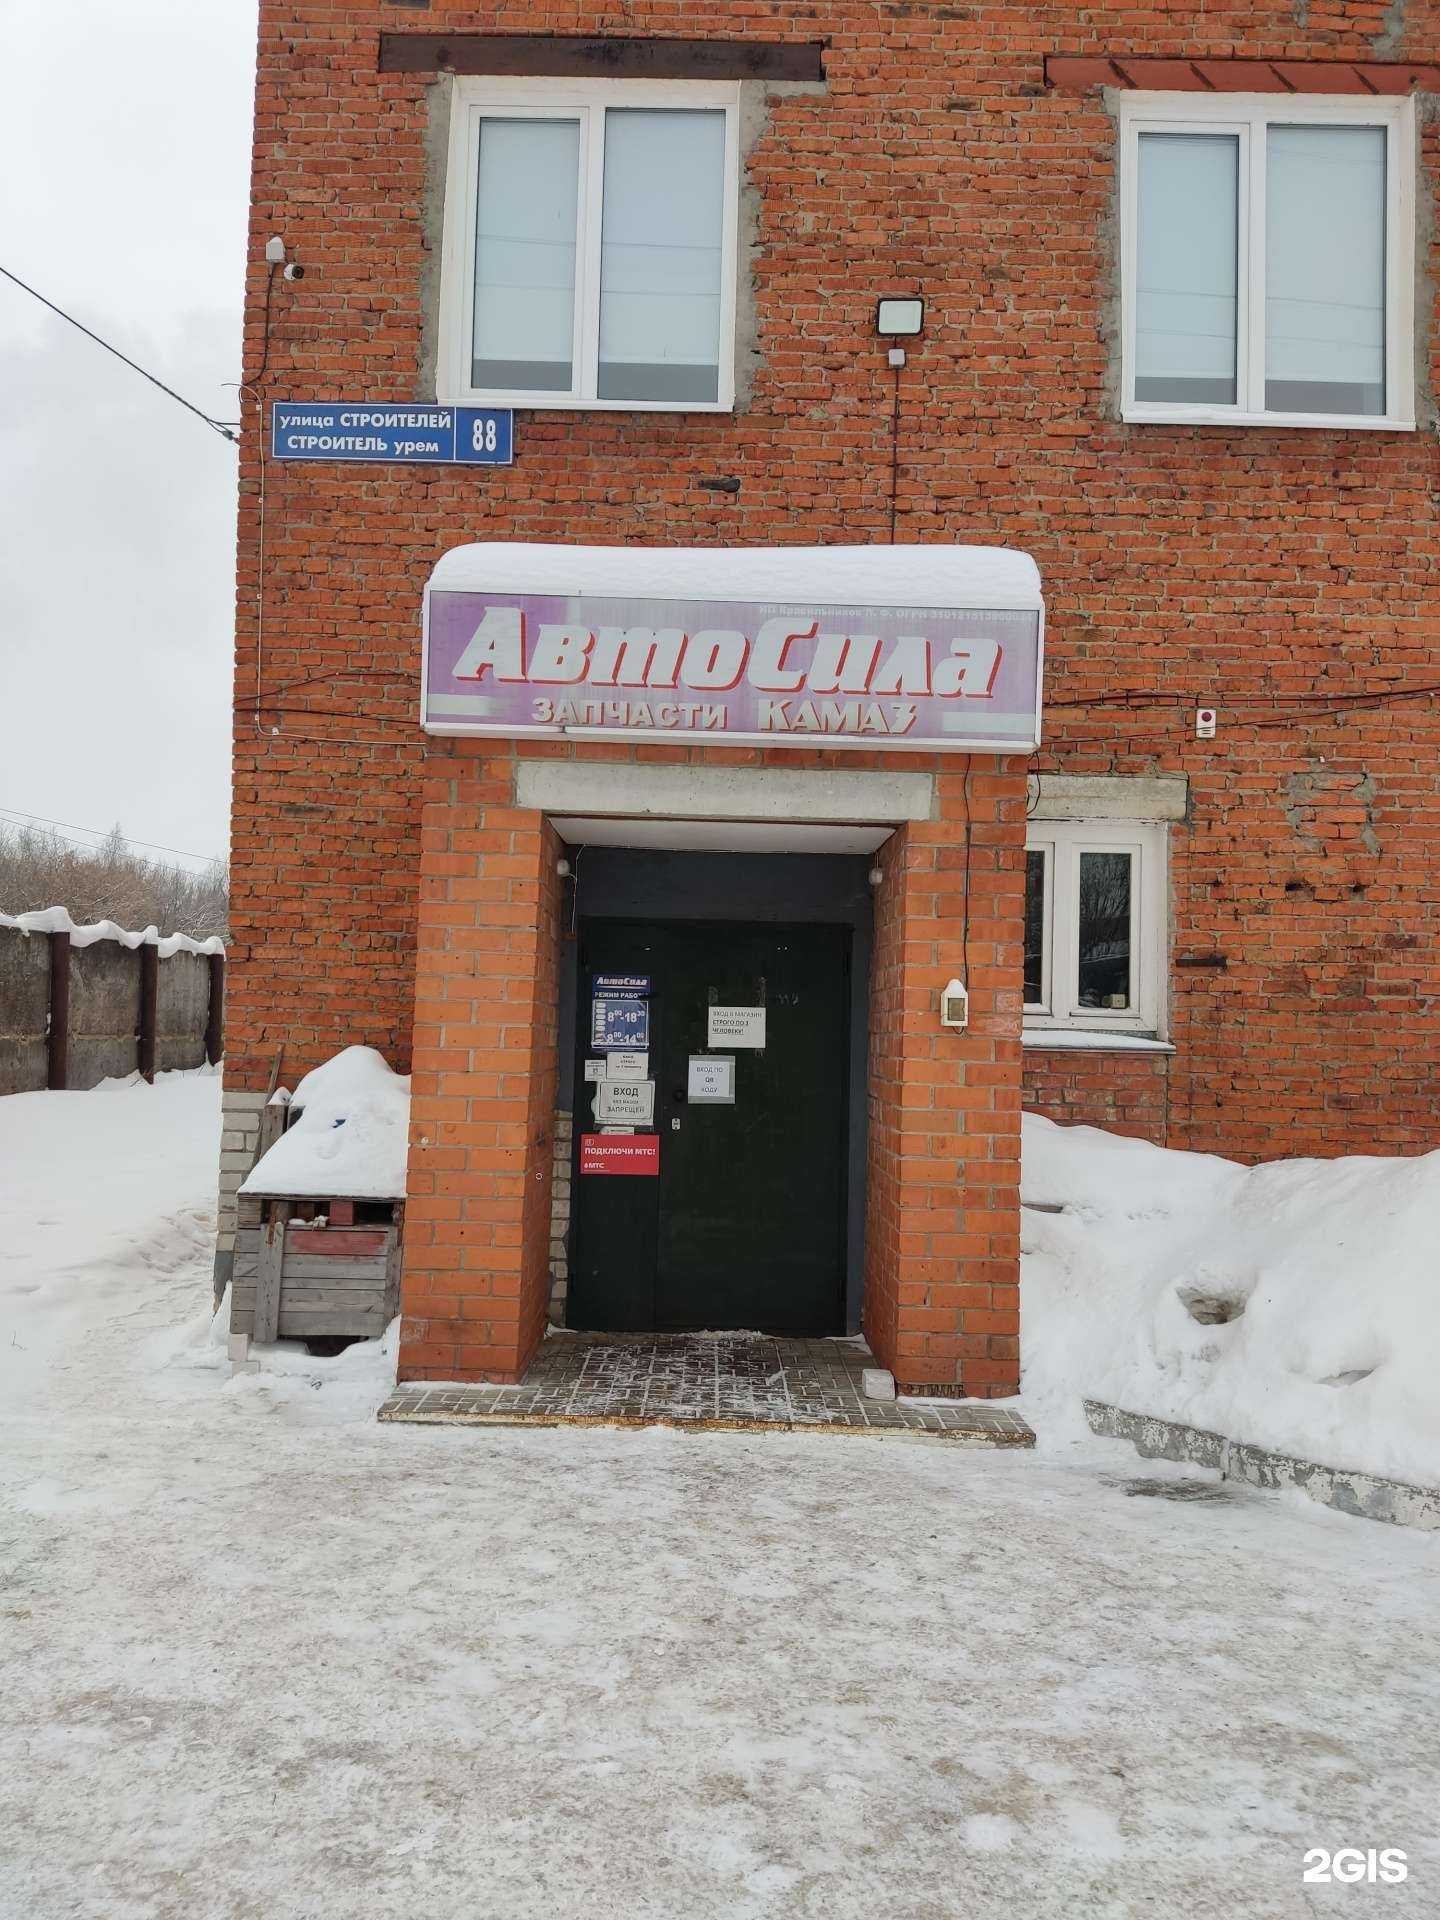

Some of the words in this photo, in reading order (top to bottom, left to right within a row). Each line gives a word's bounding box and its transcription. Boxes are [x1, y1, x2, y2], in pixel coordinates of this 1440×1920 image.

[279, 413, 334, 428] улица
[340, 411, 451, 428] СТРОИТЕЛЕЙ
[287, 435, 388, 451] СТРОИТЕЛЬ
[394, 438, 439, 454] урем
[472, 418, 497, 452] 88
[451, 606, 1002, 699] АвтоСила
[531, 696, 728, 731] ЗАПЧАСТИ
[757, 700, 917, 736] КАМАЗ
[613, 1087, 639, 1097] ВХОД
[584, 1147, 633, 1155] ПОДКЛЮЧИ
